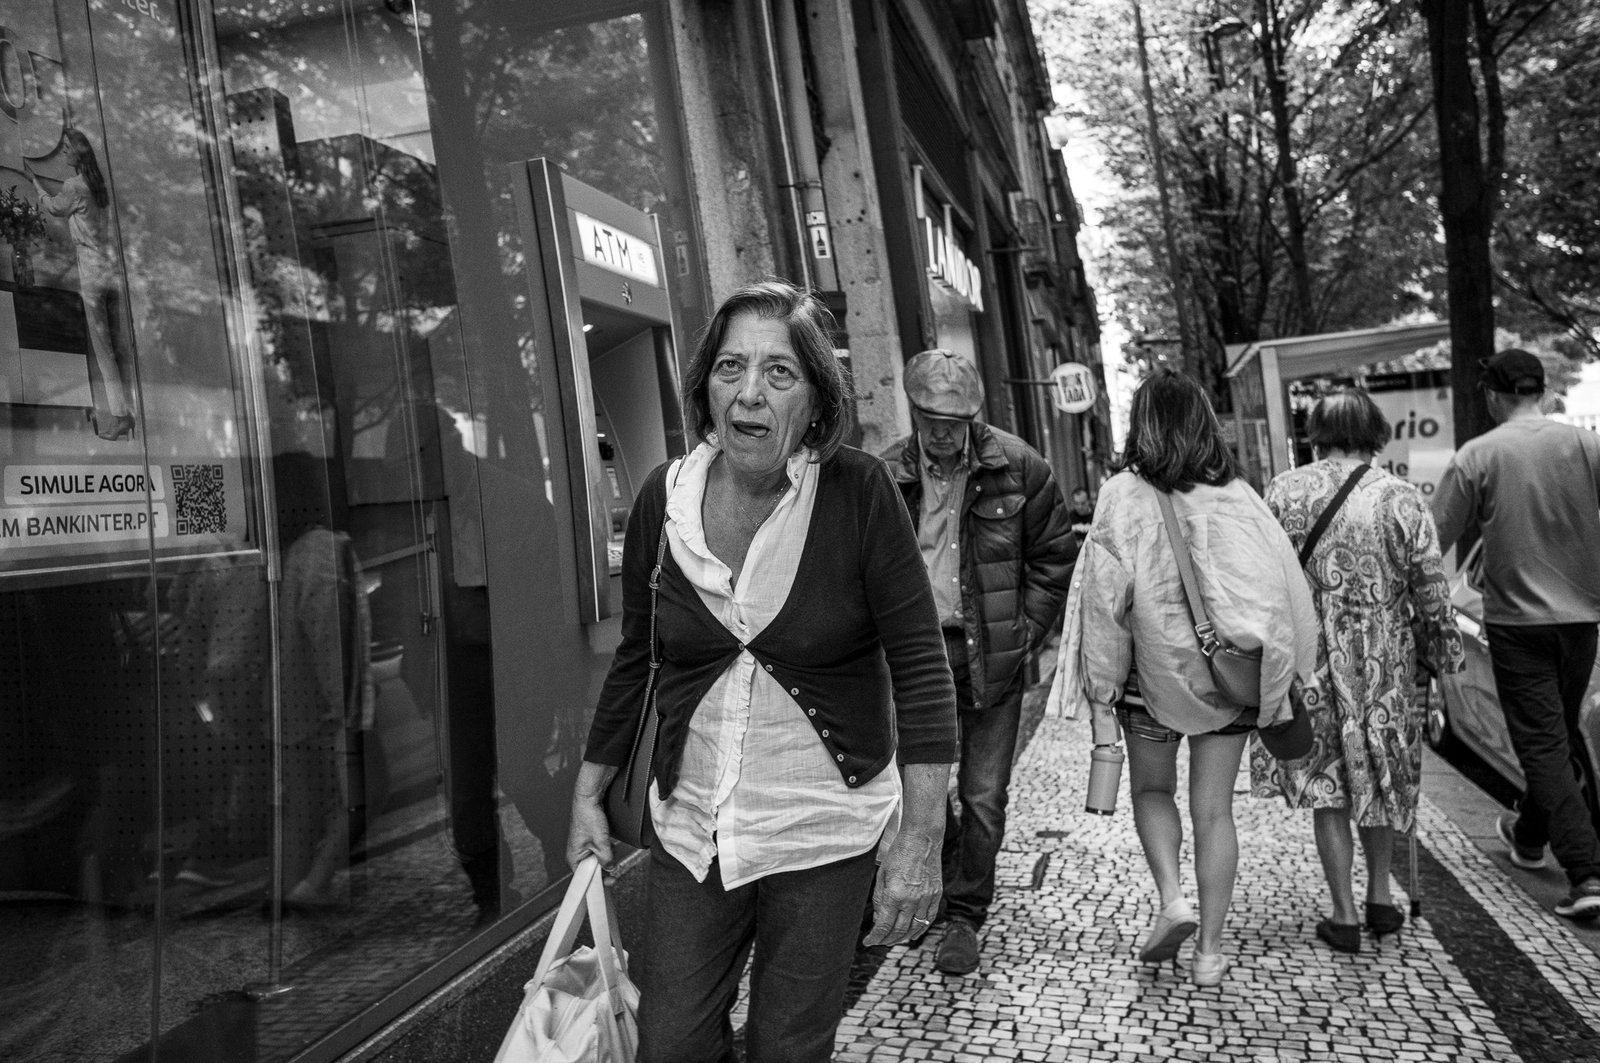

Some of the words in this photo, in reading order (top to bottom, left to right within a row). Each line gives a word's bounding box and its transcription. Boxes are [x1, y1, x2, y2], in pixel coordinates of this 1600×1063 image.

[593, 225, 633, 272] ATM
[20, 475, 95, 495] SIMULE
[0, 518, 20, 538] M
[27, 511, 159, 537] BANKINTER.PT
